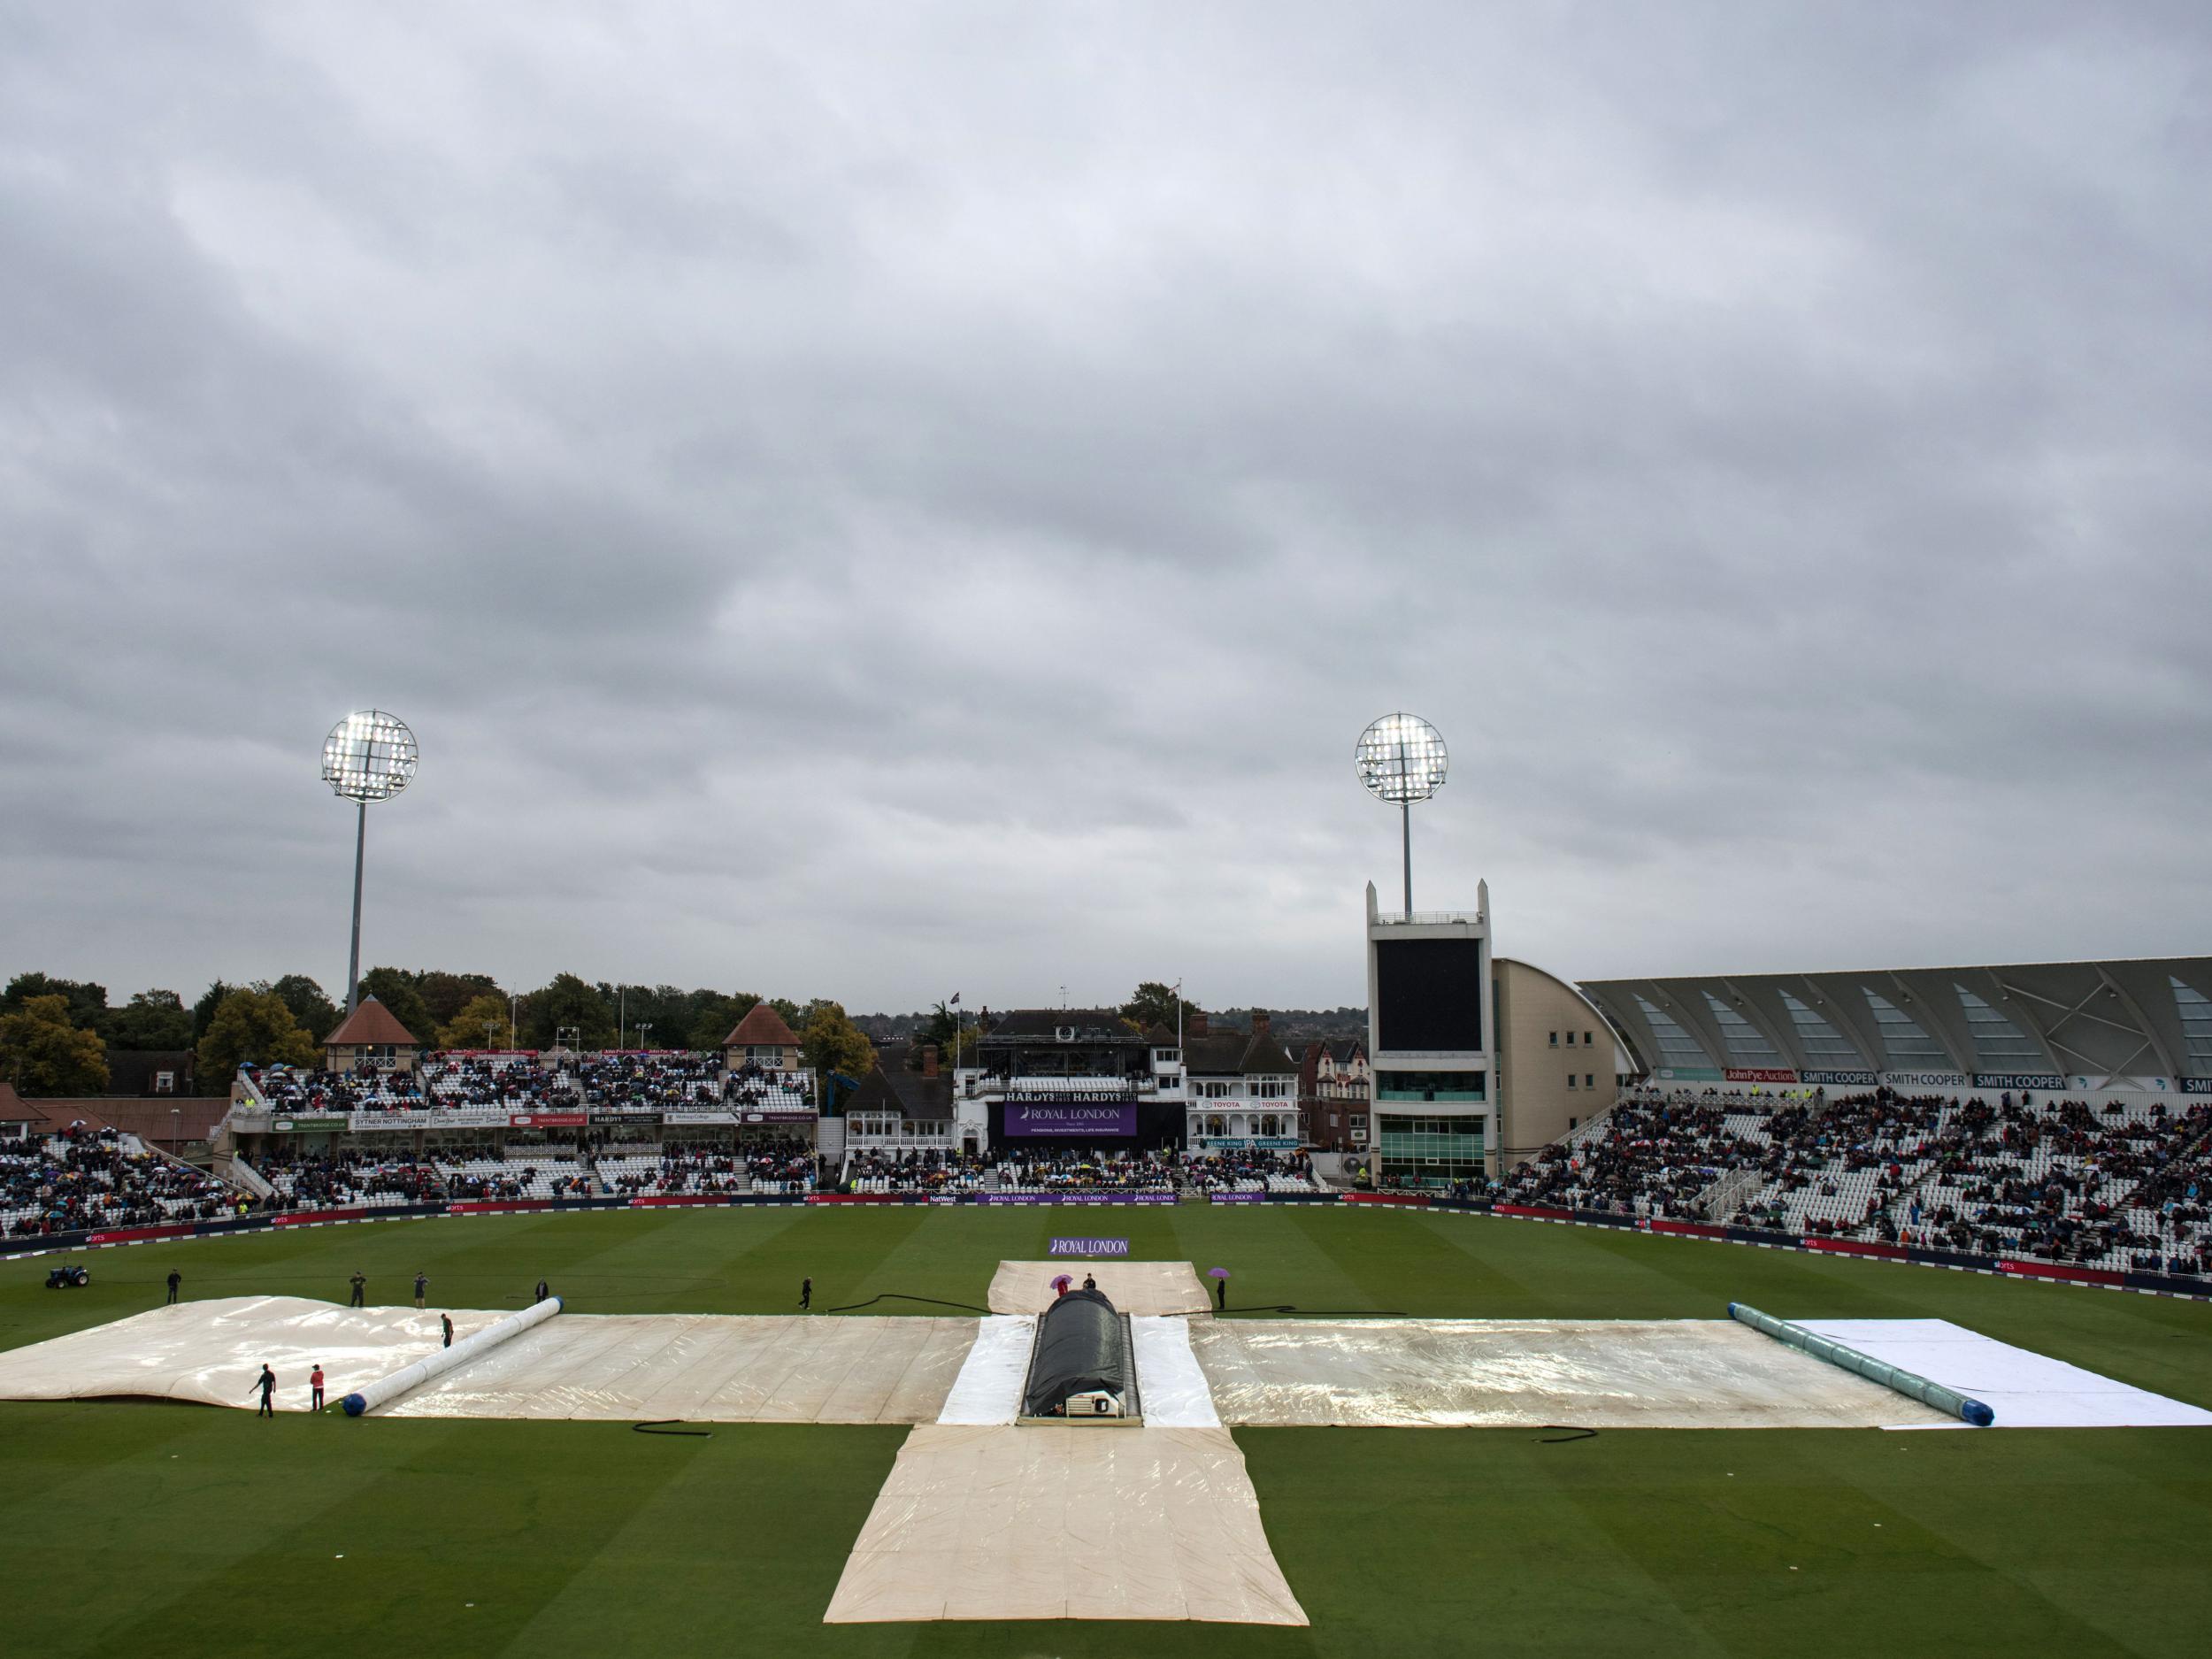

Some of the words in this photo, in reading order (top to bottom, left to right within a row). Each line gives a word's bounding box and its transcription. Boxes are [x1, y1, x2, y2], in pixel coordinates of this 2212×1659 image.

[1728, 1070, 1747, 1079] John
[1748, 1070, 1762, 1081] Pye
[1803, 1072, 1834, 1083] SMITH
[1835, 1073, 1874, 1084] COOPER
[1886, 1074, 1919, 1085] SMITH
[1920, 1075, 1965, 1086] COOPER
[1977, 1075, 2013, 1087] SMITH
[2015, 1076, 2063, 1088] COOPER
[1006, 1092, 1055, 1102] HARDYS
[1073, 1092, 1121, 1102] HARDYS
[1031, 1109, 1067, 1119] ROYAL
[1071, 1109, 1120, 1119] LONDON
[1244, 1139, 1256, 1148] IPA
[1059, 1240, 1086, 1253] ROYAL
[1089, 1240, 1128, 1253] LONDON
